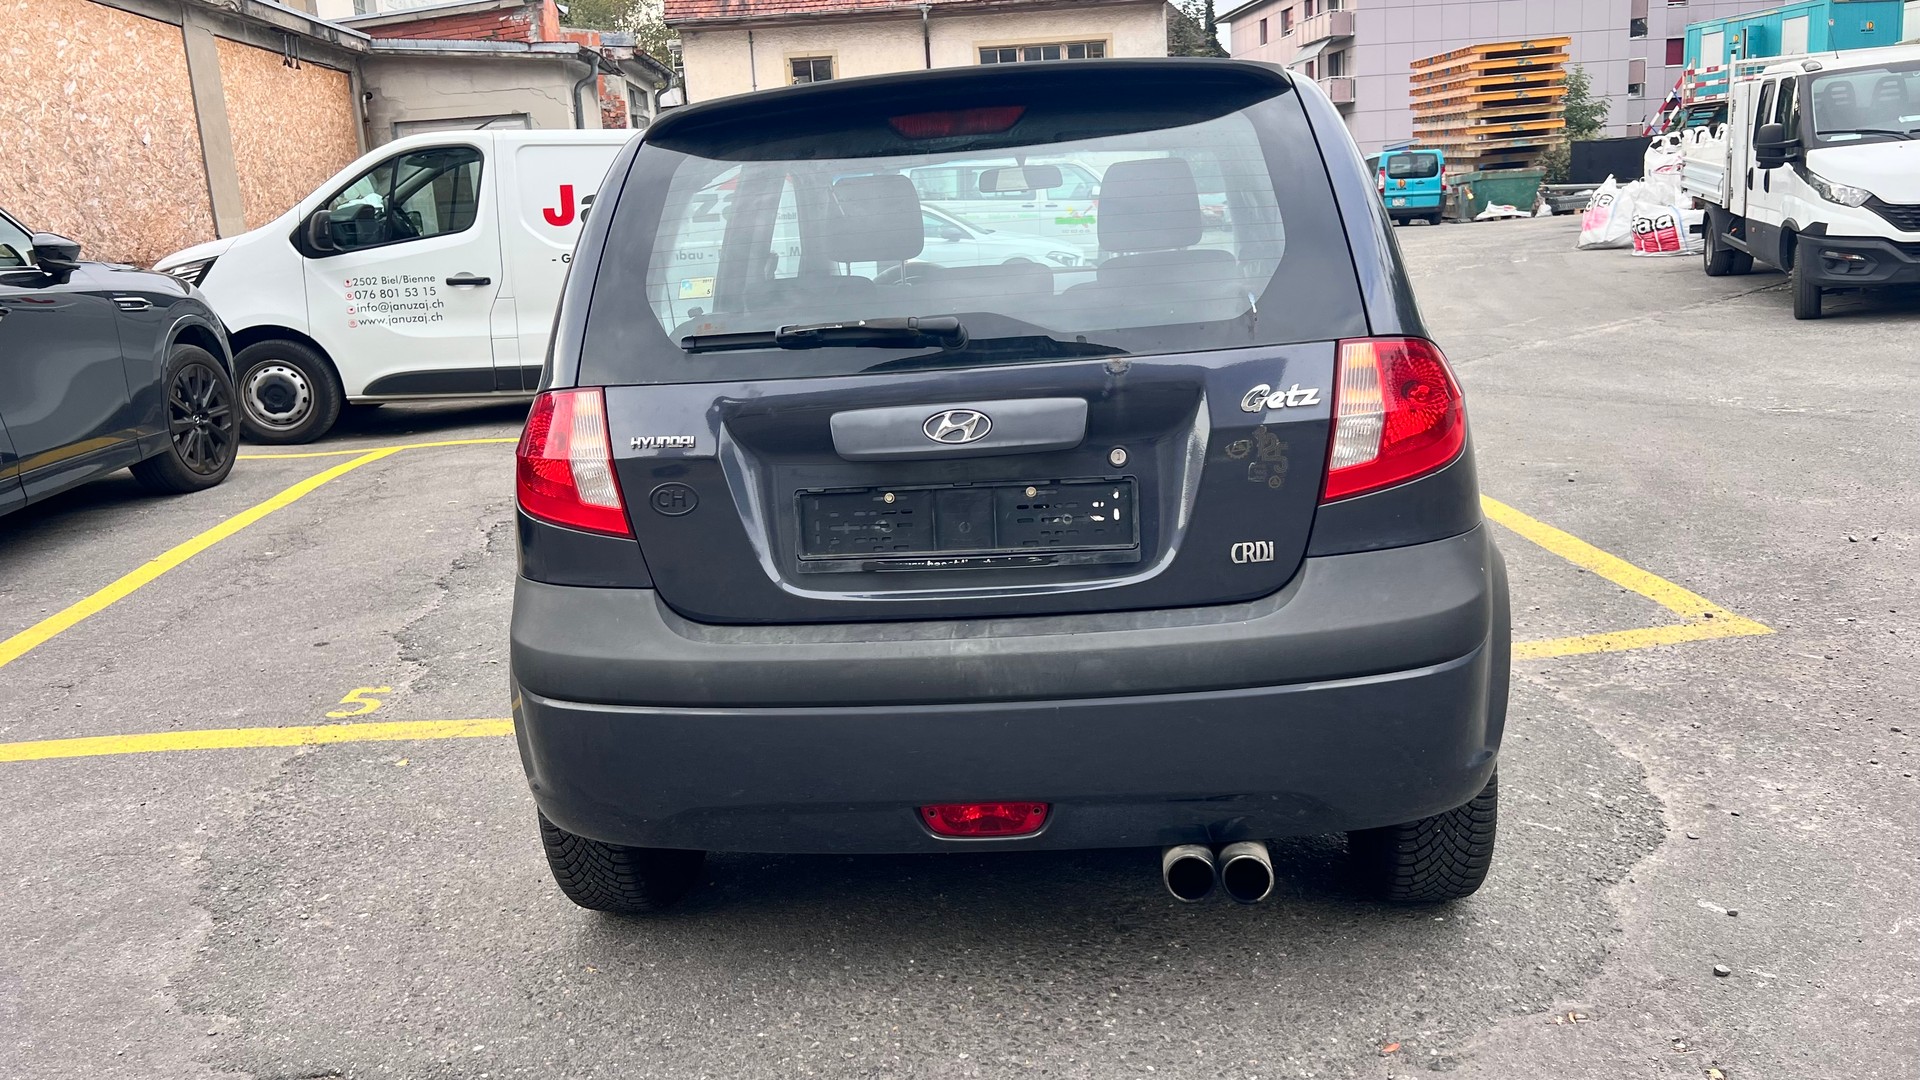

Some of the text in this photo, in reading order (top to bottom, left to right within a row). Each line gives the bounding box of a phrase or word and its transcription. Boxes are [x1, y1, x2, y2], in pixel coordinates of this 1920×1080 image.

[352, 275, 436, 287] 2502 Biel/Bienne
[354, 286, 437, 300] 076 801 53 15
[356, 299, 444, 313] info@januzaj.ch
[358, 312, 443, 326] www.januzaj.ch
[1240, 383, 1321, 413] Getz
[630, 435, 696, 449] HYUNDAI
[657, 489, 687, 507] CH
[325, 683, 393, 719] 5
